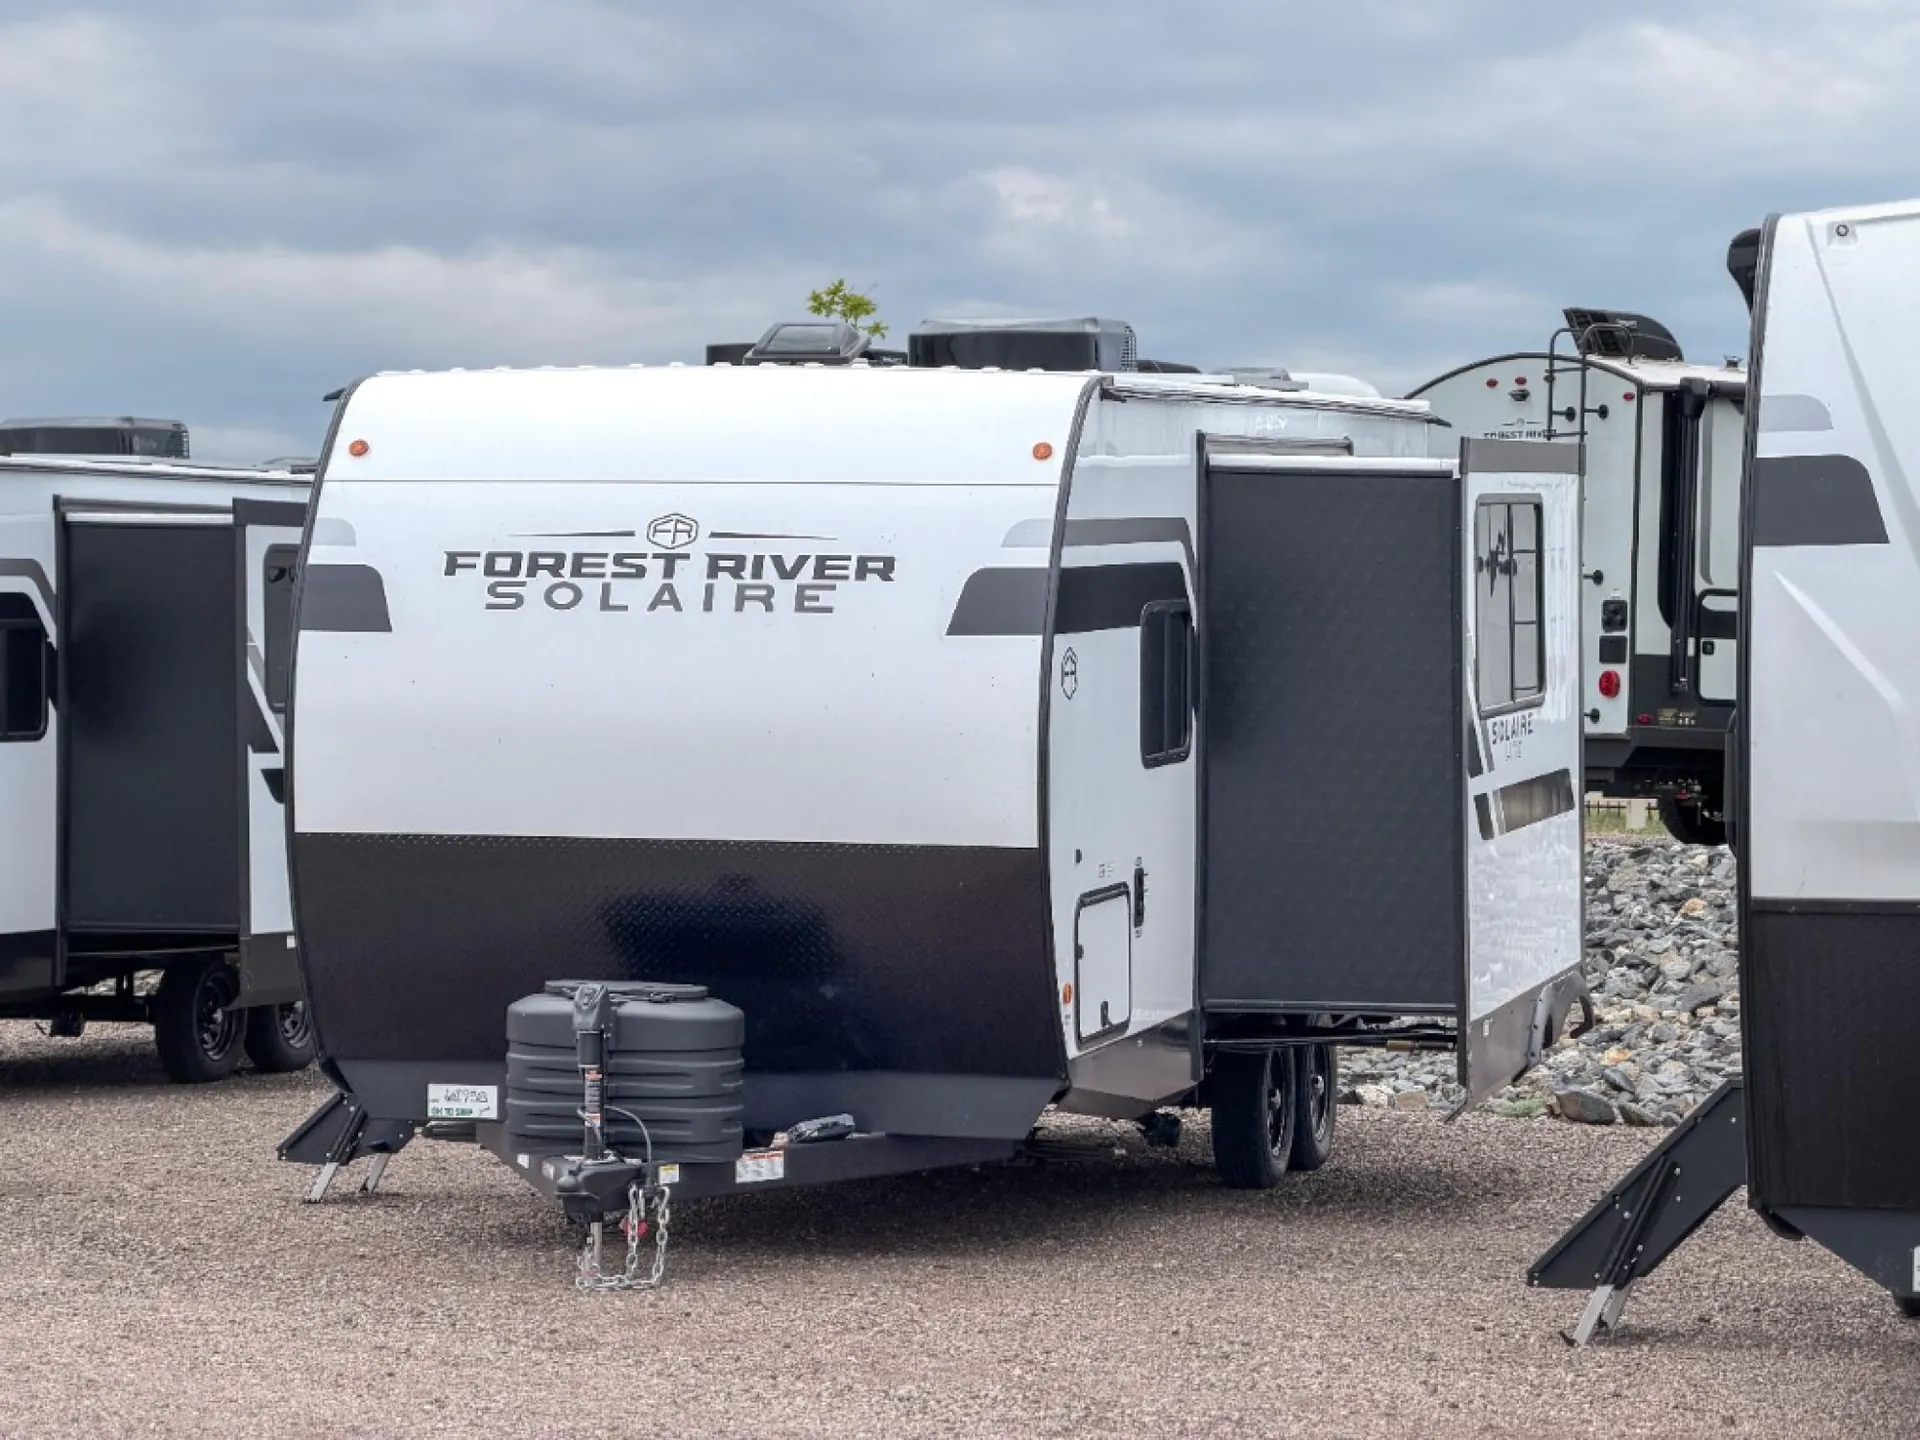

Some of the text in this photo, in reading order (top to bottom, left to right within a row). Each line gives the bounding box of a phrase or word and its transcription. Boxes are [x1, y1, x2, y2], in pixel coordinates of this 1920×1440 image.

[444, 551, 896, 581] FOREST RIVER
[484, 580, 838, 613] SOLAIRE
[1492, 713, 1534, 745] SOLAIRE
